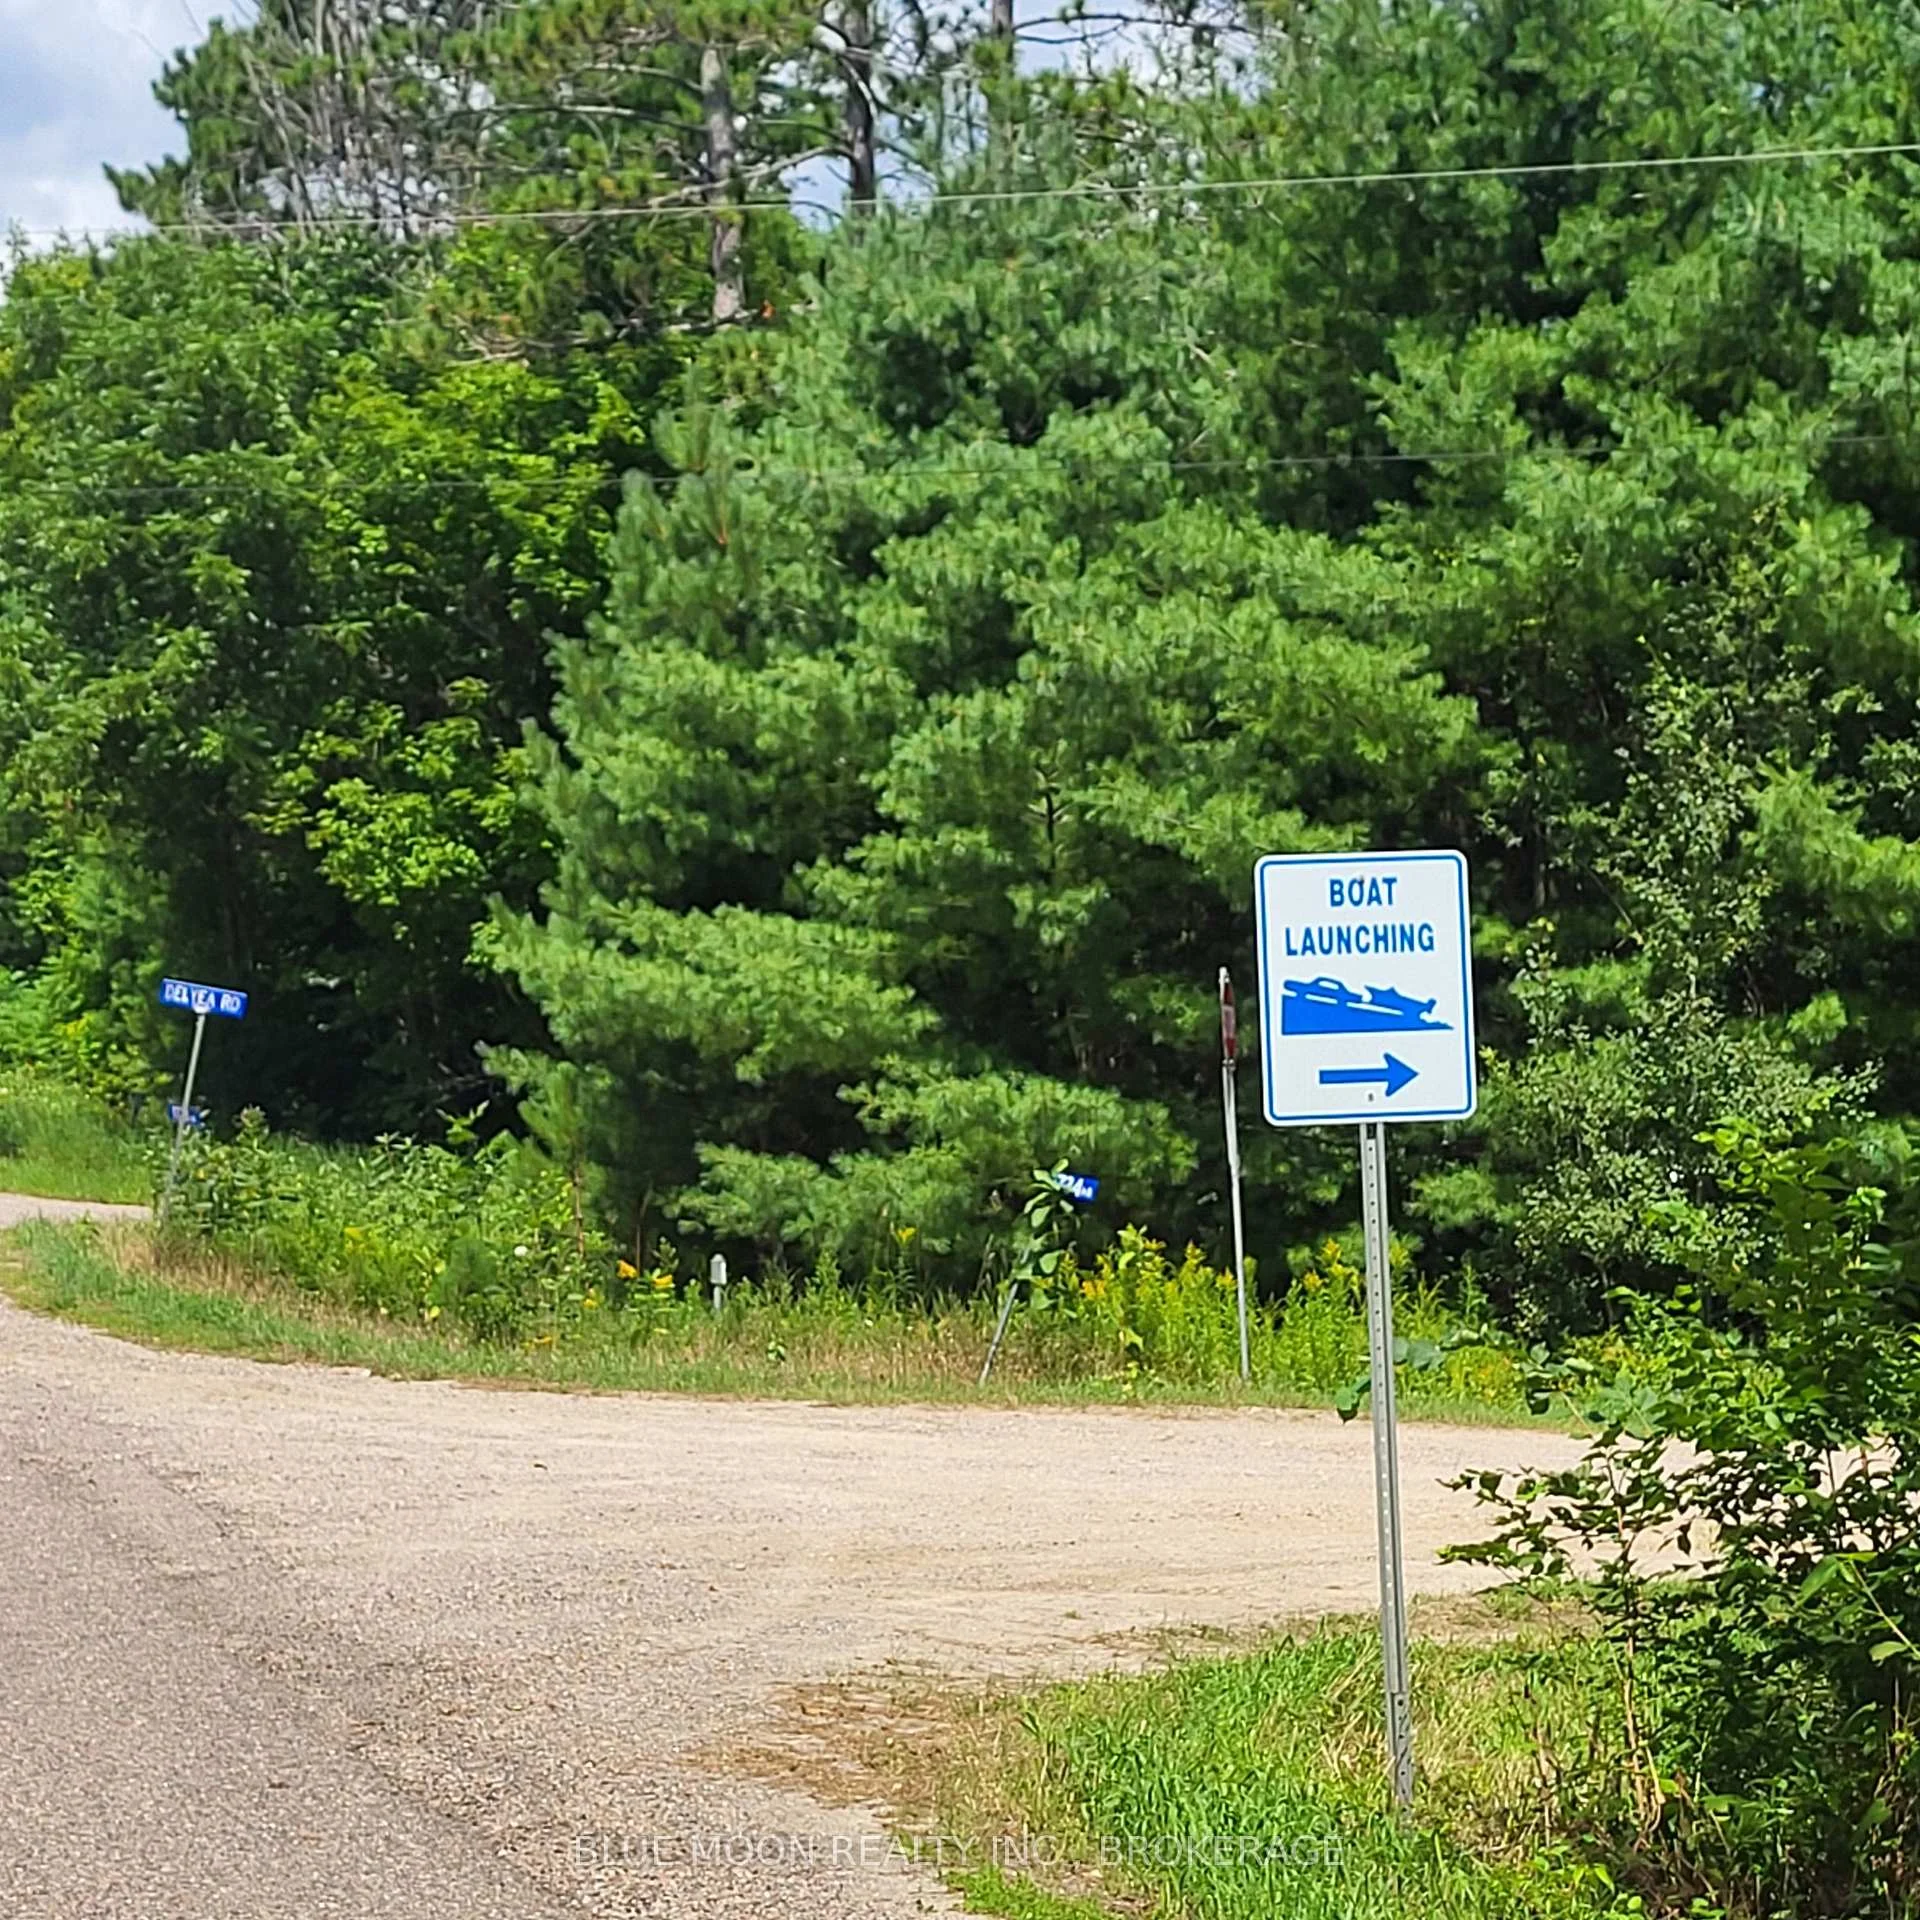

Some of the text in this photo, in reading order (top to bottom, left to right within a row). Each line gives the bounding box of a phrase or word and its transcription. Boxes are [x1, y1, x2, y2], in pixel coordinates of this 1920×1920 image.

[1330, 876, 1397, 907] BOAT
[1285, 923, 1435, 956] LAUNCHING
[220, 993, 242, 1014] RD
